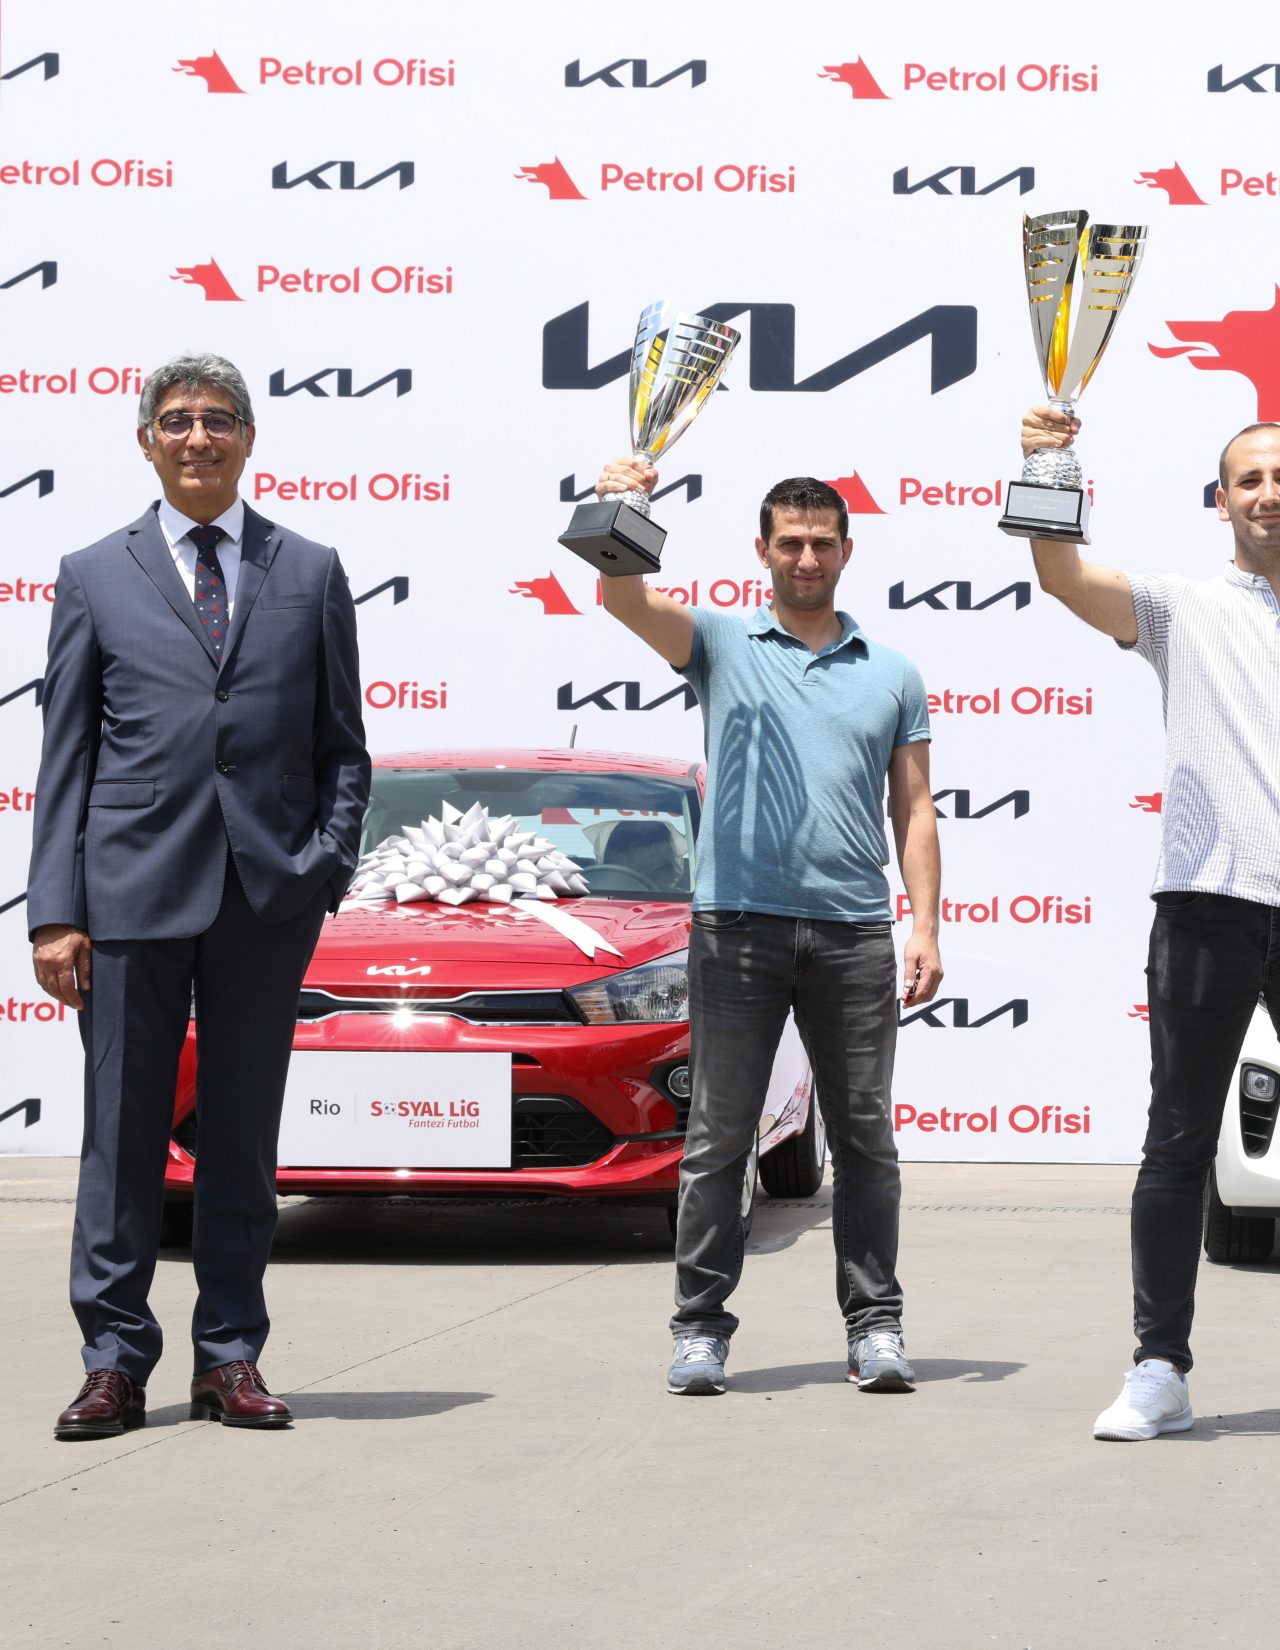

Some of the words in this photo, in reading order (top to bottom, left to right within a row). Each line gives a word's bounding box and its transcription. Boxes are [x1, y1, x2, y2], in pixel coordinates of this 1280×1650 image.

[260, 57, 362, 87] Petrol
[373, 57, 455, 87] Ofisi
[904, 63, 1005, 93] Petrol
[1017, 63, 1098, 93] Ofisi
[0, 159, 79, 186] etrol
[91, 159, 173, 188] Ofisi
[601, 163, 703, 193] Petrol
[714, 163, 796, 193] Ofisi
[257, 265, 360, 295] Petrol
[371, 265, 452, 295] Ofisi
[0, 367, 77, 395] etrol
[88, 367, 147, 395] Ofi
[255, 472, 357, 502] Petrol
[368, 472, 449, 502] Ofisi
[900, 478, 1002, 506] Petrol
[0, 578, 57, 603] etro
[709, 579, 775, 608] Ofis
[365, 681, 447, 710] Ofisi
[928, 686, 1000, 715] etrol
[1011, 686, 1092, 715] Ofisi
[896, 893, 998, 923] Ptrol
[1009, 895, 1091, 924] Ofisi
[0, 997, 65, 1022] trol
[310, 1099, 341, 1115] Rio
[896, 1104, 997, 1134] Petrol
[1008, 1104, 1090, 1134] Ofisi
[409, 1118, 445, 1128] Fantezi
[447, 1119, 480, 1129] Futbol
